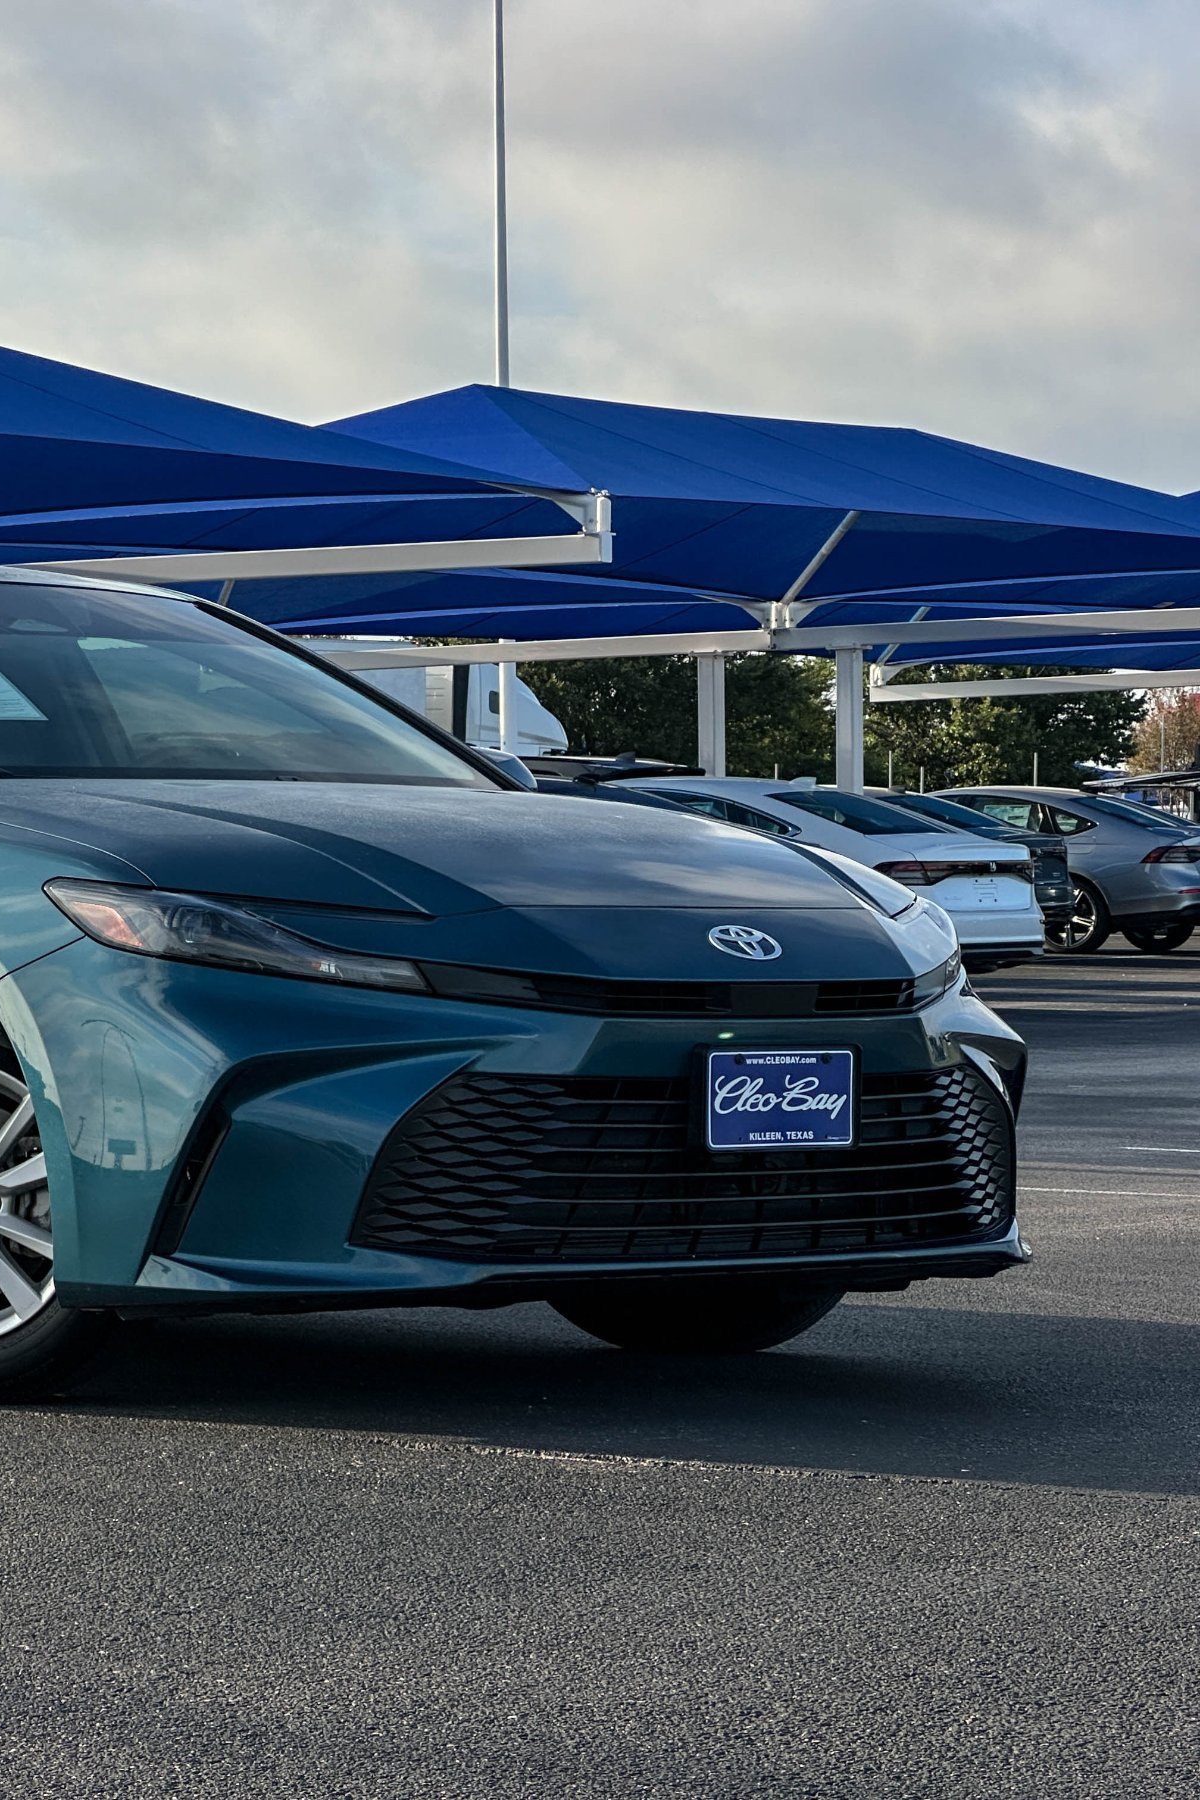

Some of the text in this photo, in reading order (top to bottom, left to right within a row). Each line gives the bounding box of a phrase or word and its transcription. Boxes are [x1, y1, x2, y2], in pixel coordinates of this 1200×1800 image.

[746, 1056, 817, 1065] www.CLEOBAY.com
[714, 1074, 847, 1120] Cleo Bay
[749, 1131, 814, 1141] KILLEEN, TEXAS
